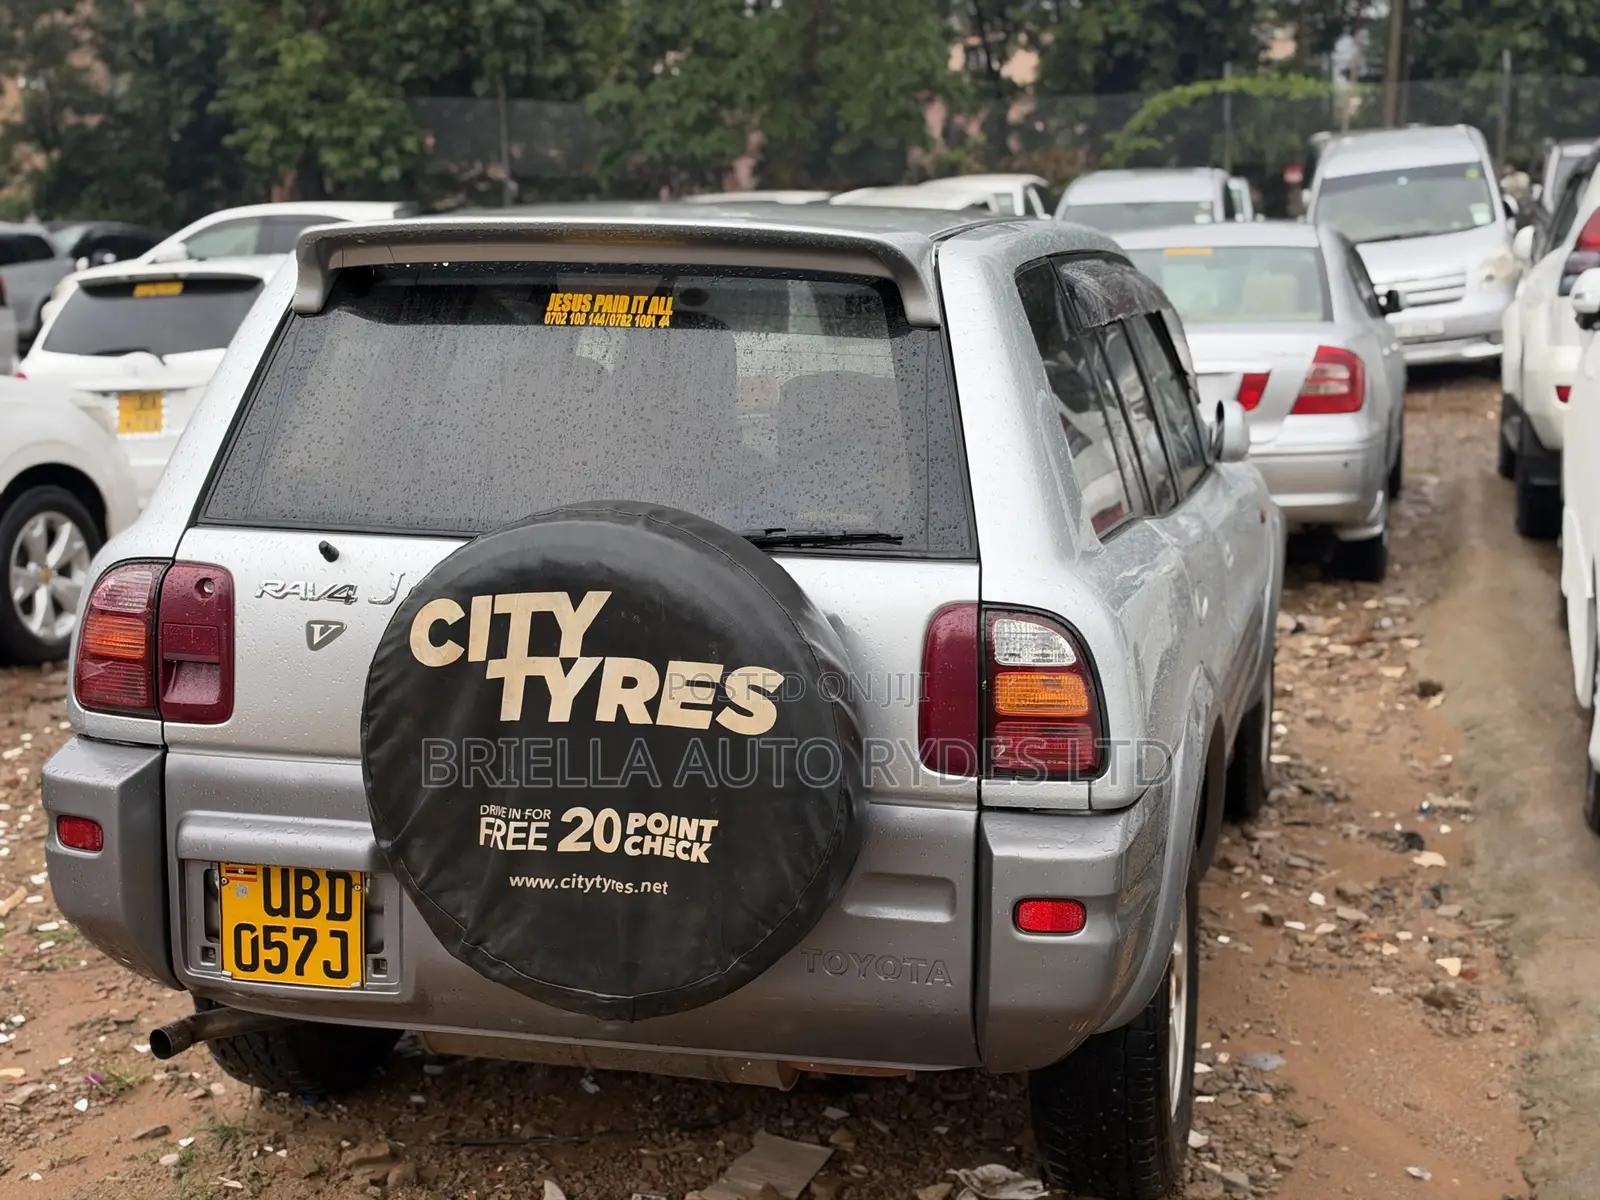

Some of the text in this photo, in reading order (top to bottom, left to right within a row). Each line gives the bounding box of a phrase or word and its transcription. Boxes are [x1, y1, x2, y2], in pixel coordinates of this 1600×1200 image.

[544, 311, 567, 325] 0702
[546, 293, 674, 316] JESUS PAID IT ALL
[254, 572, 406, 605] RAV4 J
[409, 591, 613, 667] CITY
[486, 656, 786, 735] TYRES
[480, 804, 552, 820] DRIVE IN FOR
[625, 812, 719, 842] POINT
[479, 806, 622, 853] FREE 20
[624, 835, 713, 863] CHECK
[262, 867, 353, 922] UBD
[509, 873, 668, 896] www.citytyres.net
[233, 922, 349, 980] 057J
[800, 948, 954, 987] TOYOTA
